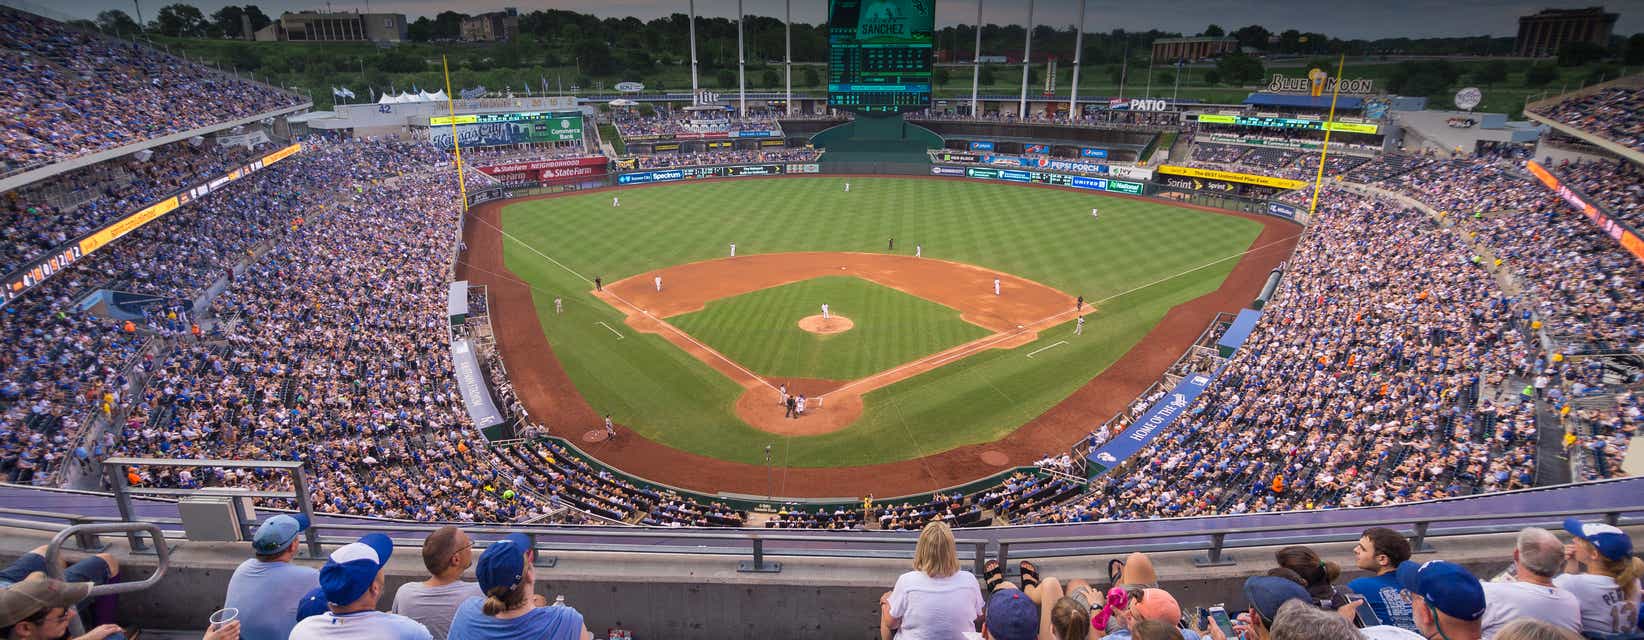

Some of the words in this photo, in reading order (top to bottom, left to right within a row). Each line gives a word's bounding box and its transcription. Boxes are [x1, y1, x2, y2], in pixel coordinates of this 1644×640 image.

[862, 23, 903, 34] SANCHEZ
[1266, 73, 1309, 92] BLUE
[1326, 77, 1374, 93] MOON
[699, 90, 720, 104] Lite
[379, 104, 392, 113] 42
[1131, 99, 1167, 111] PATIO
[479, 121, 500, 136] City
[531, 159, 580, 169] NEIGHBORHOOD
[1051, 161, 1071, 170] PEPSI
[1072, 163, 1099, 172] PORCH
[653, 172, 681, 180] Spectrum
[1074, 179, 1098, 187] UNITED
[1116, 182, 1139, 190] National
[1167, 178, 1192, 190] Sprint
[1208, 182, 1226, 191] Sprint
[1130, 422, 1157, 441] HOME
[1150, 413, 1165, 423] OF
[1160, 404, 1177, 417] THE
[1610, 602, 1637, 633] 13
